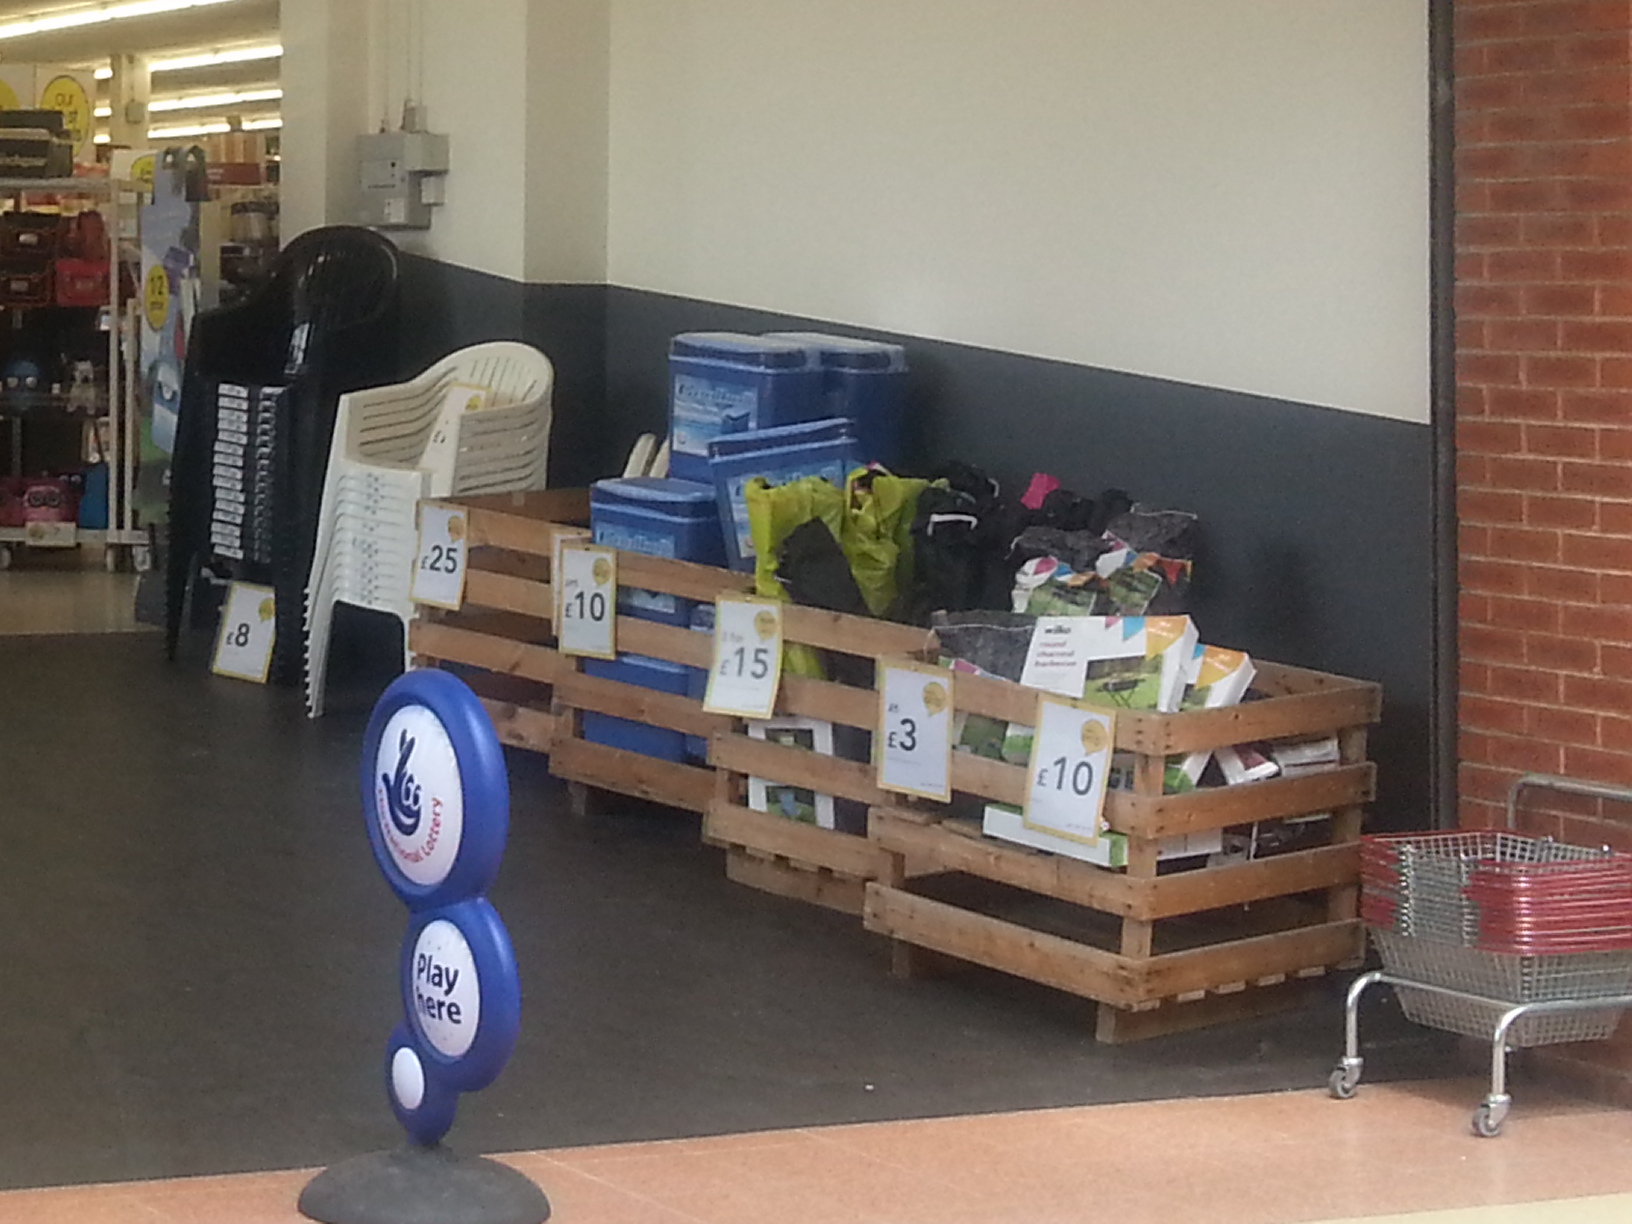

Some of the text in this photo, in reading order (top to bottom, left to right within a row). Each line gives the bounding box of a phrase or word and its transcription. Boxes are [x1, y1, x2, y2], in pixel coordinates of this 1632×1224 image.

[421, 544, 458, 574] £25
[565, 590, 606, 622] £10
[226, 623, 250, 648] £8
[720, 647, 769, 680] £15
[887, 718, 917, 752] £3
[1036, 755, 1094, 796] £10
[417, 952, 460, 997] Play
[416, 985, 462, 1025] here
